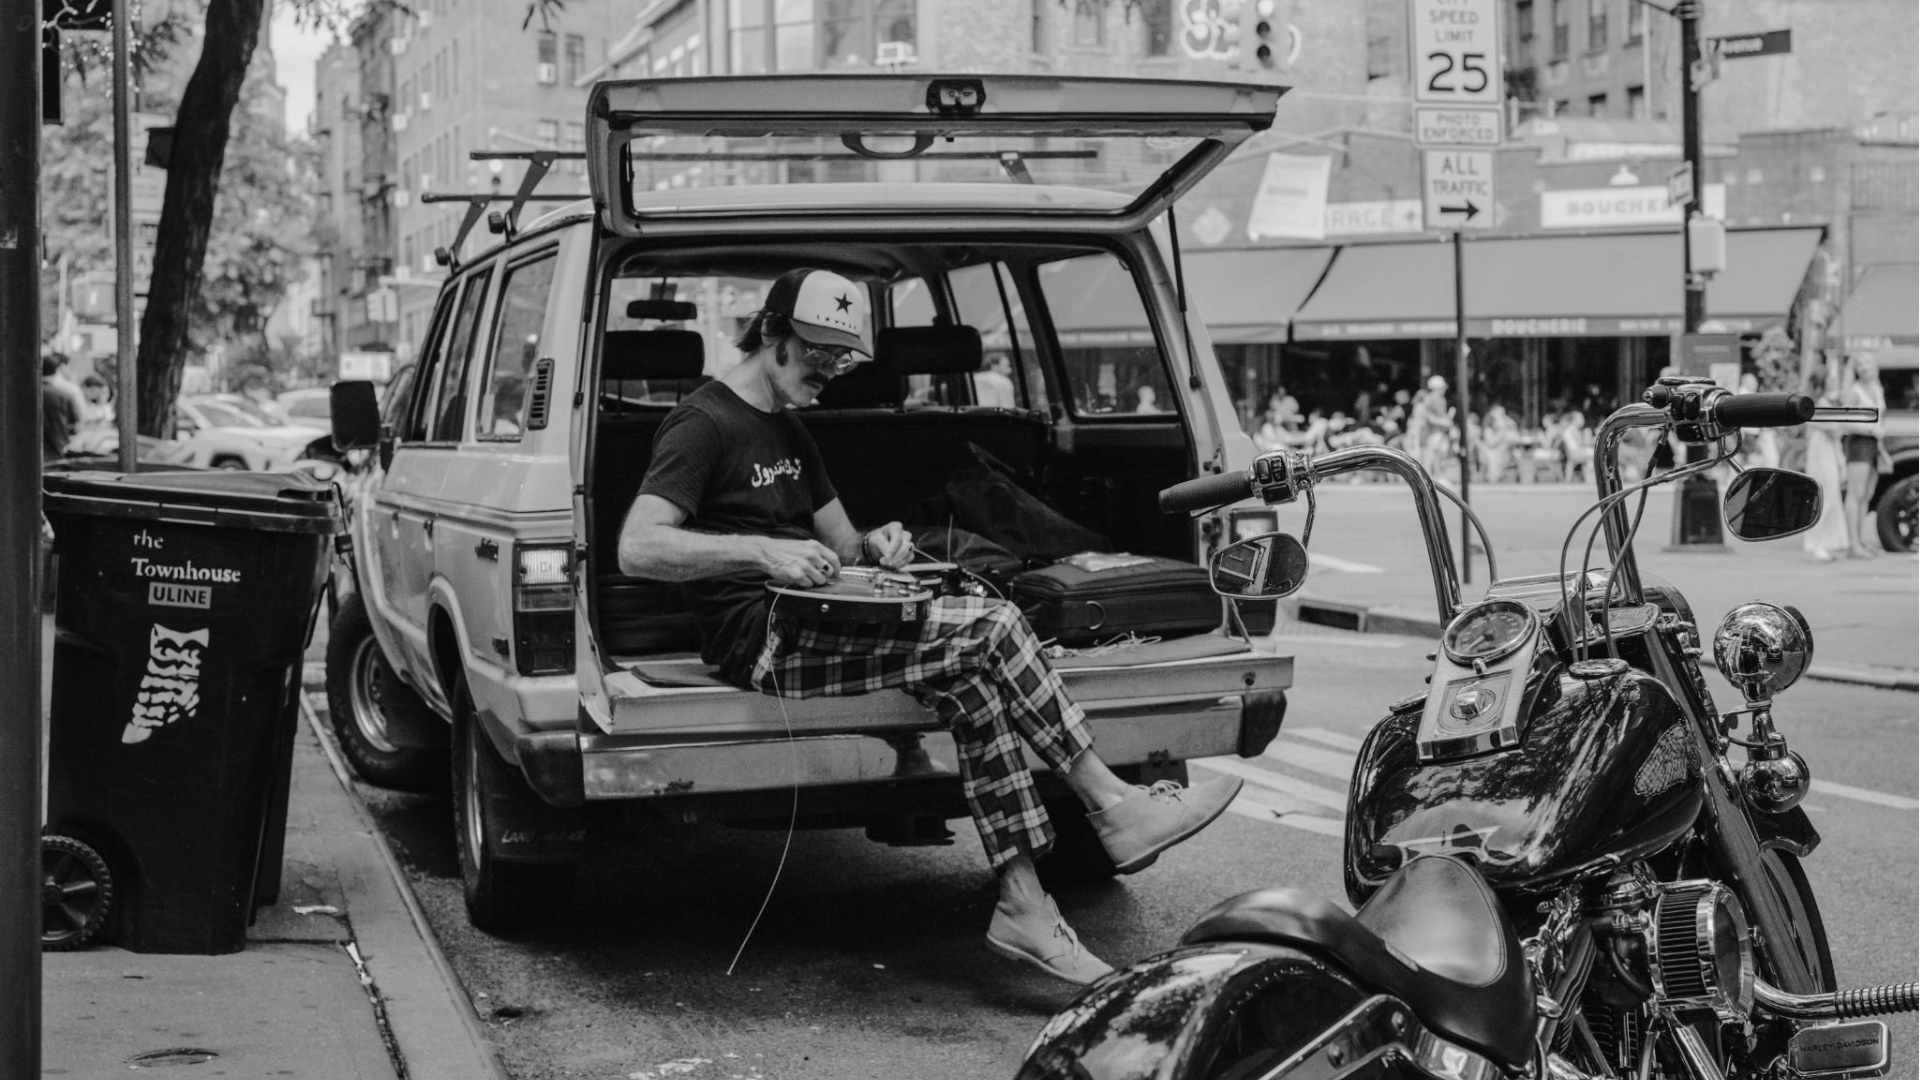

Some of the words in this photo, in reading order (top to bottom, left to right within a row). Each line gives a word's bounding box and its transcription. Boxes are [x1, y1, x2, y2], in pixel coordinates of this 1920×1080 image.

[1429, 9, 1479, 24] SPEED
[1434, 29, 1474, 43] LIMIT
[1428, 52, 1487, 92] 25
[1436, 113, 1480, 126] PHOTO
[1423, 127, 1494, 140] ENFORCED
[1441, 156, 1479, 174] ALL
[1432, 179, 1489, 196] TRAFFIC
[133, 529, 164, 549] the
[131, 557, 241, 582] Townhouse
[153, 586, 207, 605] ULINE
